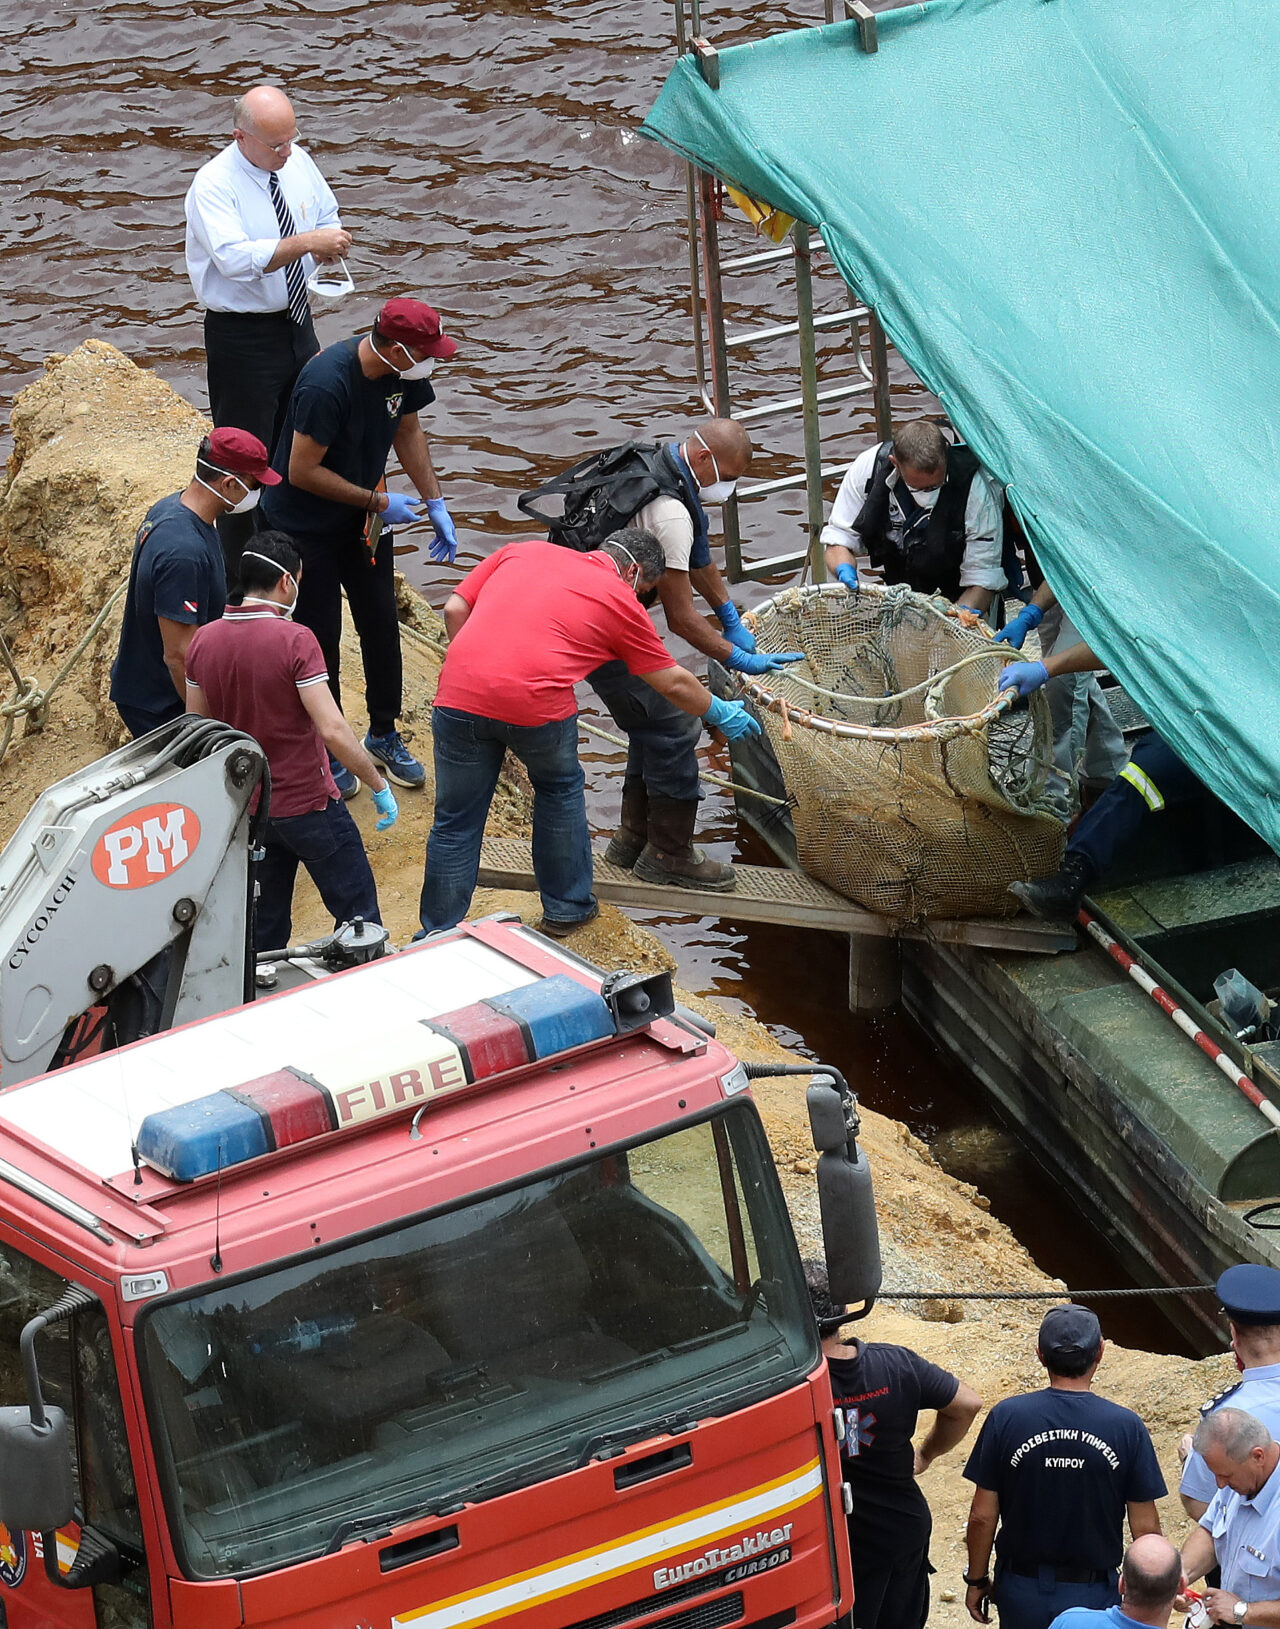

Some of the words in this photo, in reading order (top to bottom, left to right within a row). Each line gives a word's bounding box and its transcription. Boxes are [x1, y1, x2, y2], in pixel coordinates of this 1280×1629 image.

[104, 808, 189, 885] PM
[8, 872, 77, 971] CYCOACH
[336, 1053, 462, 1122] FIRE
[1010, 1429, 1079, 1468] ΠΥΡΟΣΒΕΣΤΙΚΗ
[1081, 1431, 1121, 1470] ΥΠΗΡΕΣΙΑ
[1045, 1457, 1085, 1469] ΚΥΠΡΟΥ
[653, 1522, 793, 1590] EuroTrakker
[724, 1548, 790, 1583] CURSOR
